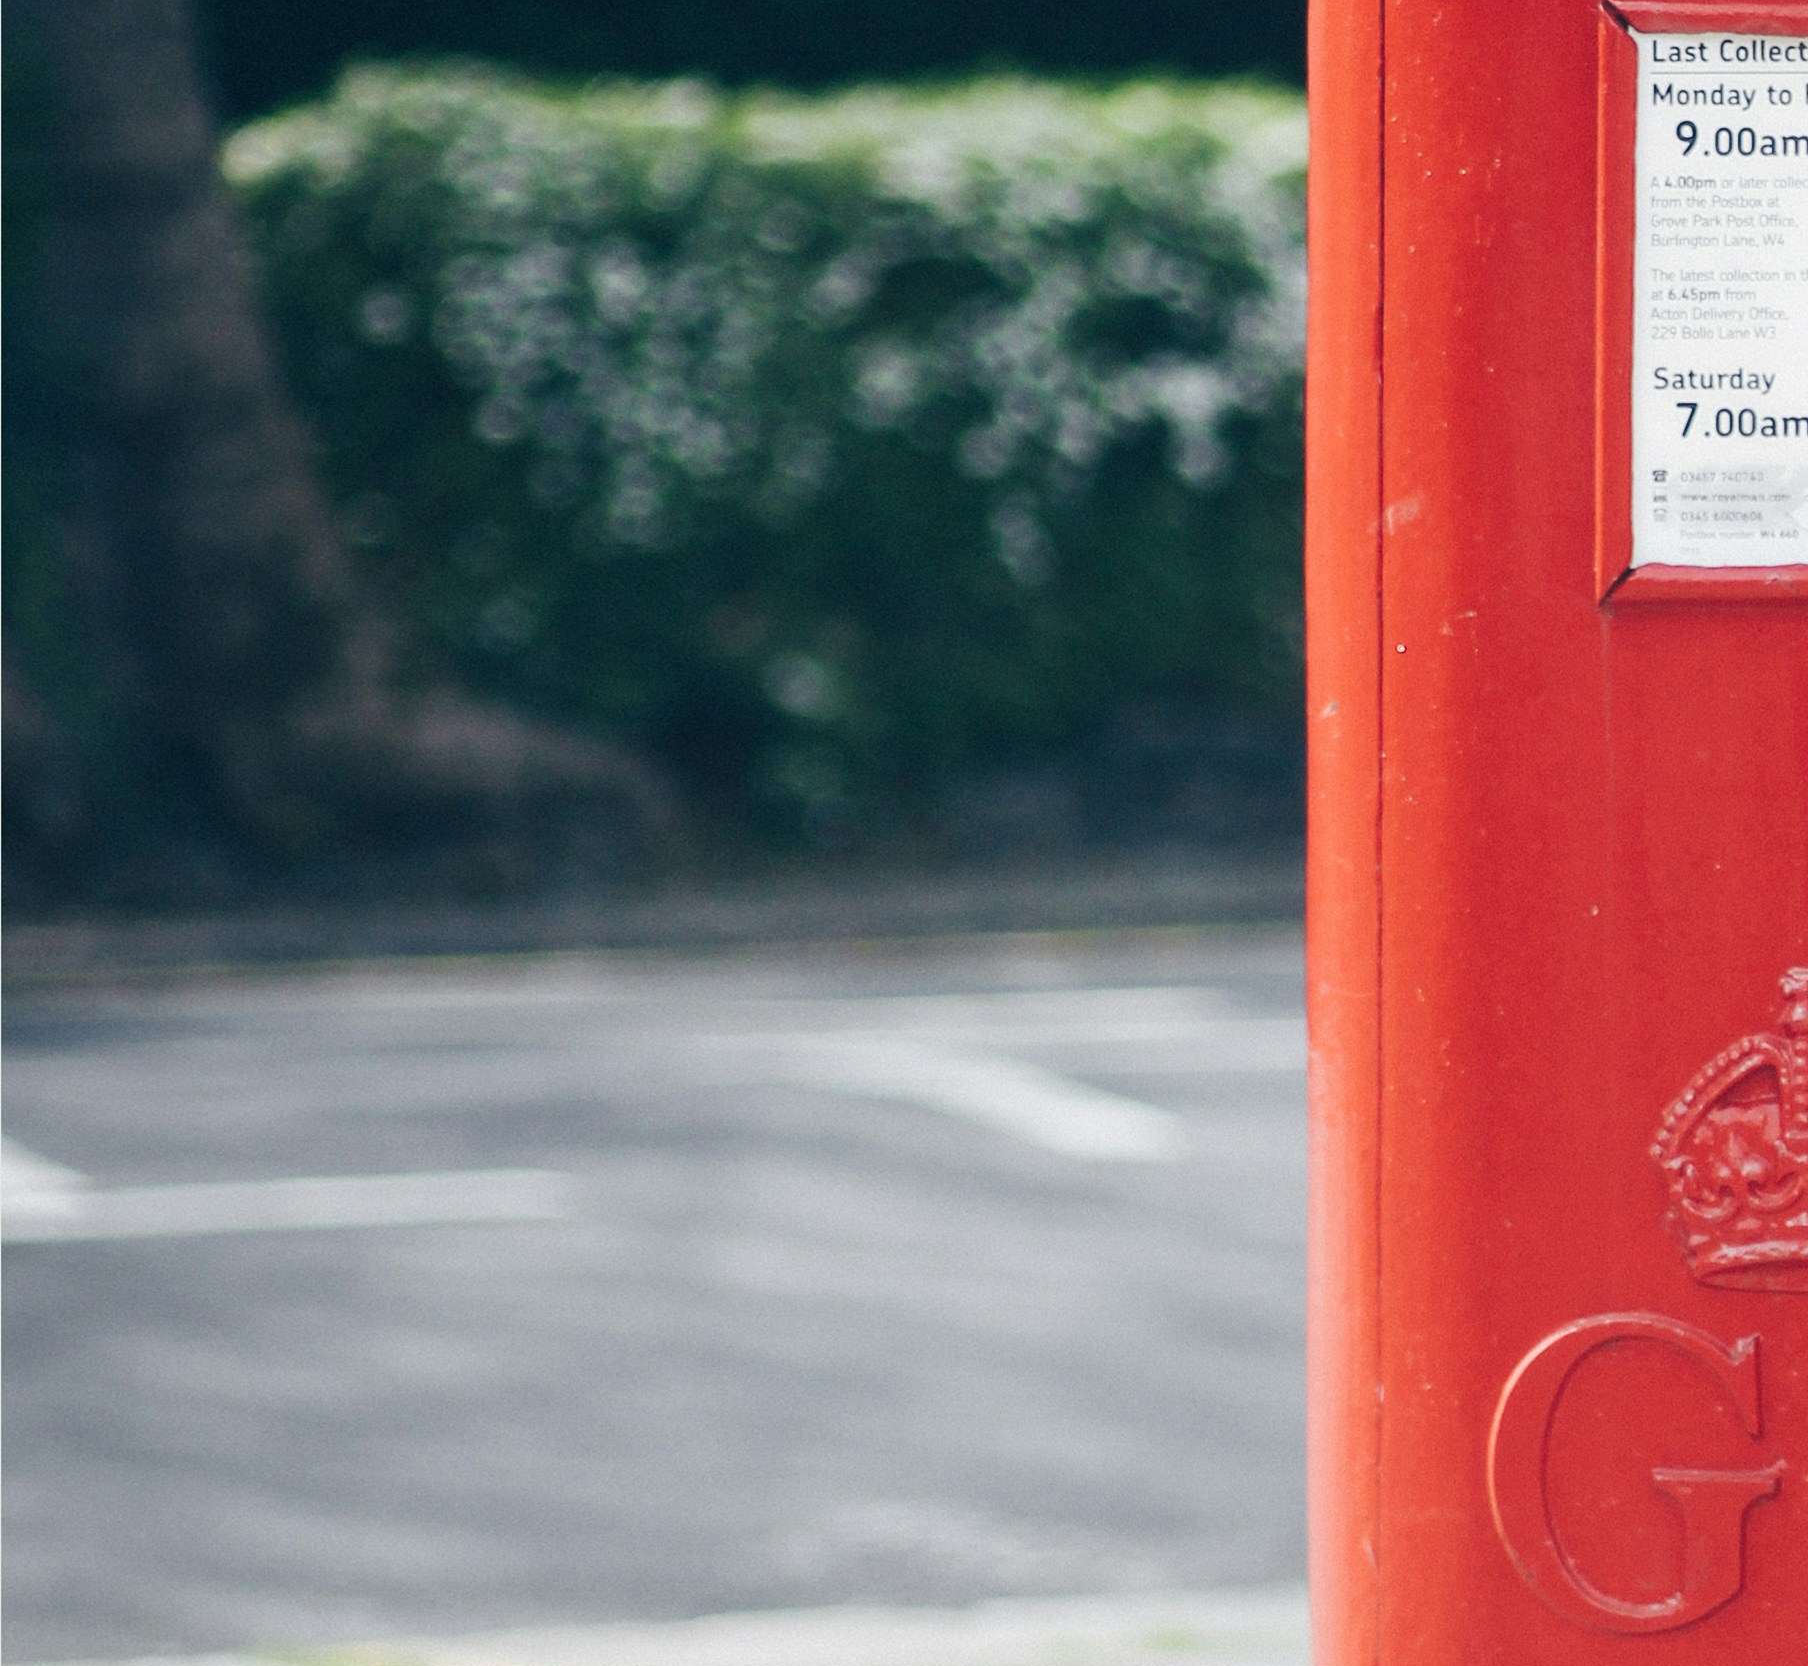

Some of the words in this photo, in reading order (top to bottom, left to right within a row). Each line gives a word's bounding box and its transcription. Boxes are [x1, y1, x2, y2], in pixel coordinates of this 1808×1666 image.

[1653, 40, 1707, 62] Last
[1652, 83, 1757, 111] Monday
[1768, 86, 1791, 105] to
[1651, 177, 1659, 187] A
[1664, 177, 1716, 190] 4.00pm
[1722, 180, 1734, 188] or
[1740, 177, 1768, 188] later
[1651, 196, 1681, 207] from
[1686, 196, 1706, 207] the
[1712, 196, 1761, 207] Postbox
[1767, 197, 1779, 207] at
[1651, 215, 1687, 227] Grove
[1693, 215, 1720, 226] Park
[1727, 215, 1754, 227] Post
[1651, 234, 1718, 248] Burlington
[1762, 235, 1784, 246] W4
[1651, 269, 1675, 281] The
[1680, 269, 1714, 281] latest
[1720, 269, 1779, 281] collection
[1785, 270, 1795, 281] in
[1651, 290, 1663, 300] at
[1668, 289, 1720, 303] 6.45pm
[1725, 289, 1755, 300] from
[1651, 308, 1687, 320] Acton
[1692, 307, 1743, 322] Delivery
[1651, 327, 1676, 339] 229
[1719, 327, 1749, 339] Lane
[1653, 367, 1776, 394] Saturday
